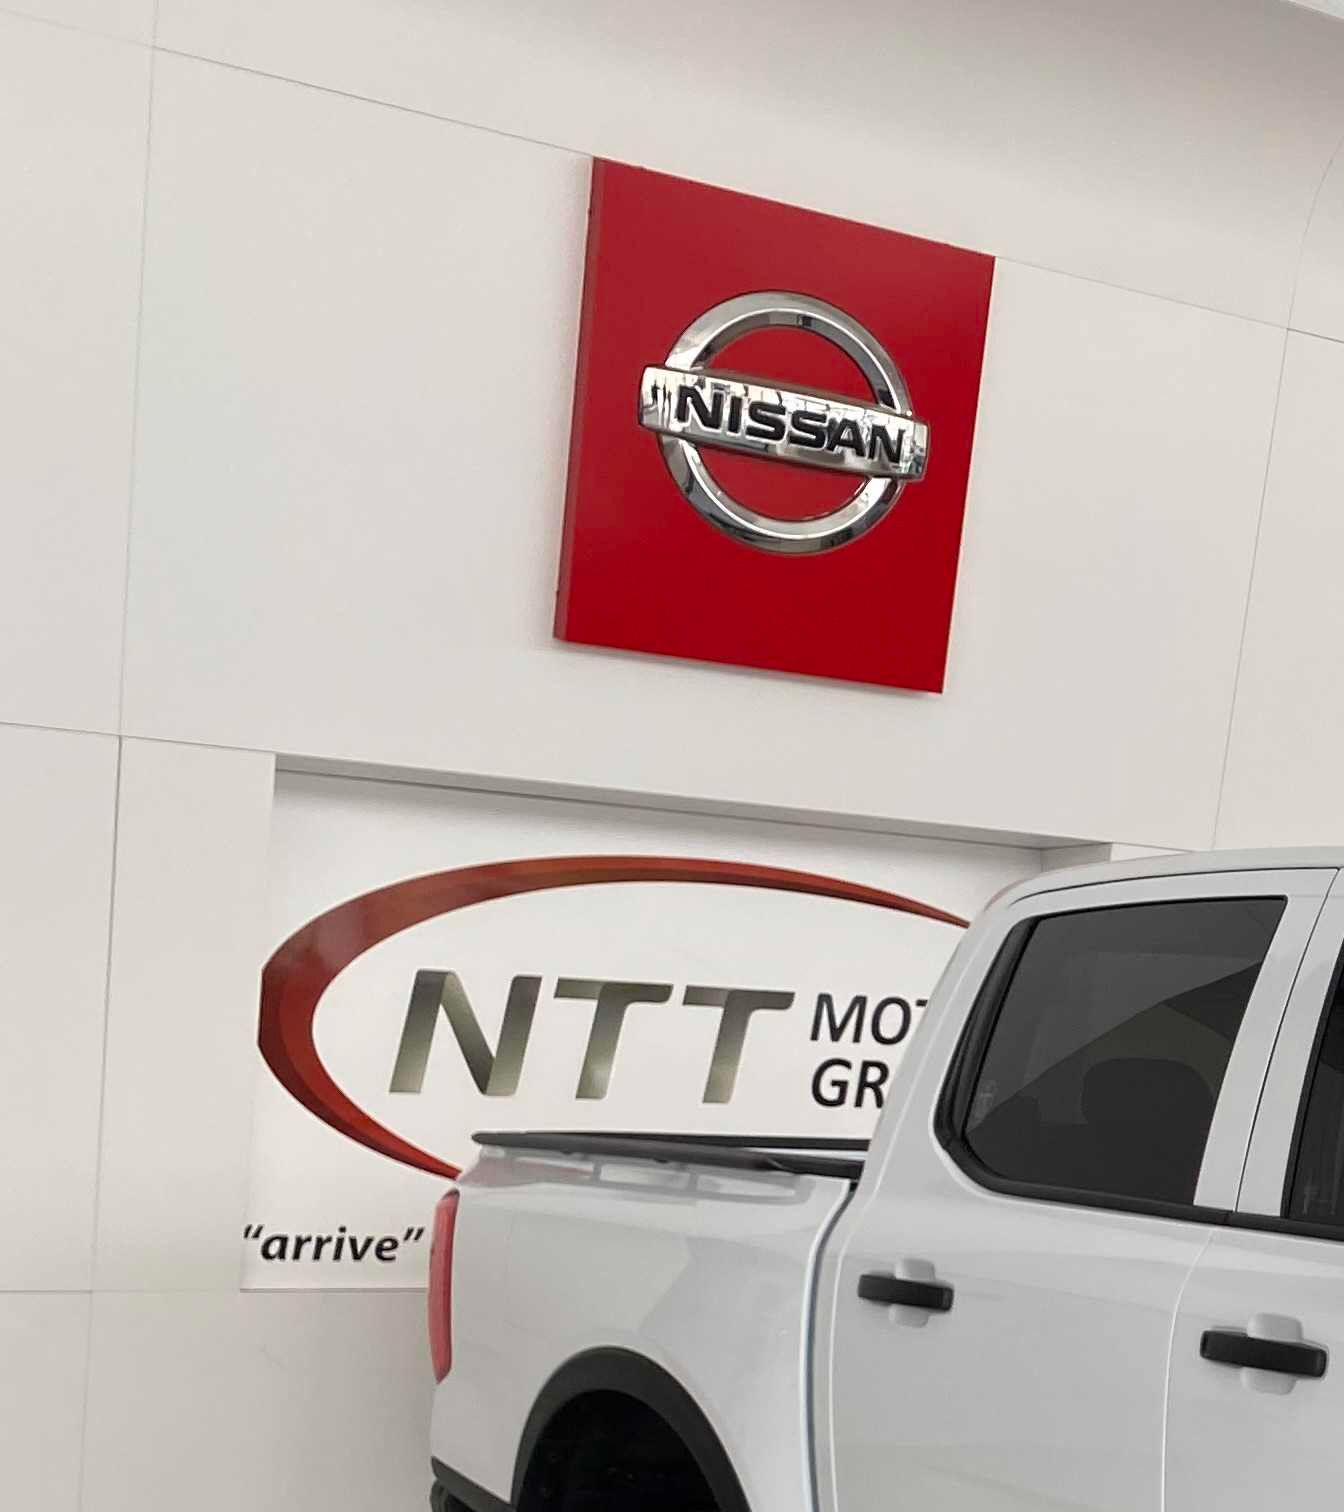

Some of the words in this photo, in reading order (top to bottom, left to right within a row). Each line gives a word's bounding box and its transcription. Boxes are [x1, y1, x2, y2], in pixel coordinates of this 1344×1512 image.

[674, 384, 905, 464] NISSAN
[388, 968, 796, 1104] NTT
[810, 992, 928, 1045] MO
